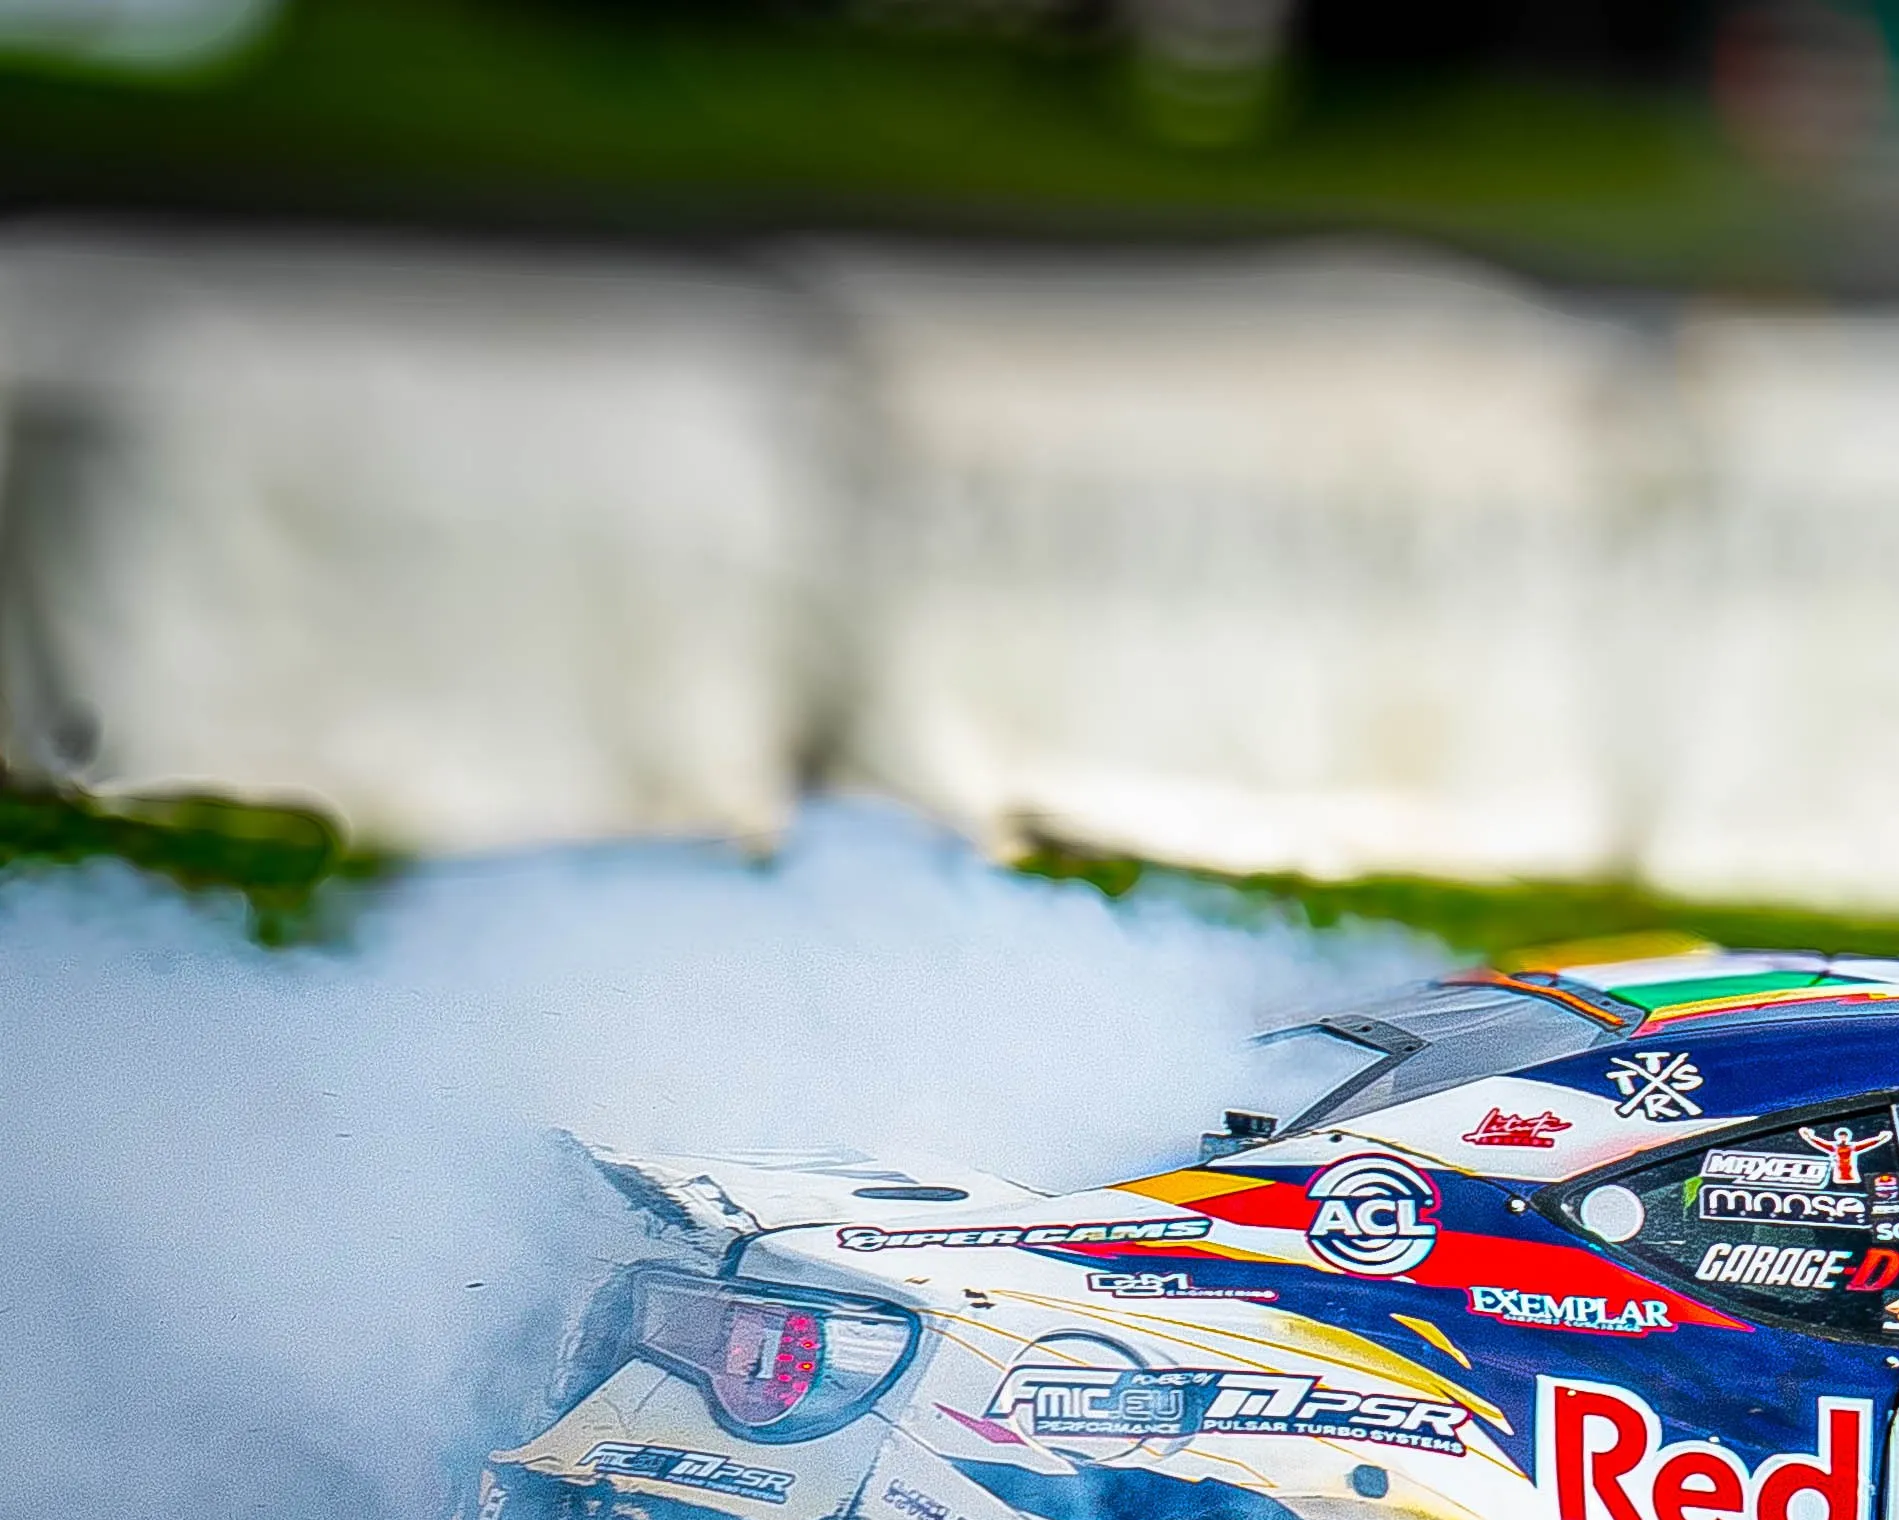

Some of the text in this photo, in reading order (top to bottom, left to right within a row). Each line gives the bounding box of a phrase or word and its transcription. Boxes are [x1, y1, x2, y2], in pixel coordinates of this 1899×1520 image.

[1023, 1219, 1211, 1244] CAMS
[1309, 1199, 1436, 1236] ACL
[1469, 1286, 1674, 1328] EXEMPLAR
[1036, 1420, 1182, 1436] PERFORMANCE
[1303, 1394, 1471, 1434] PSR
[1203, 1418, 1465, 1455] PULSAR TURBO SYSTEMS
